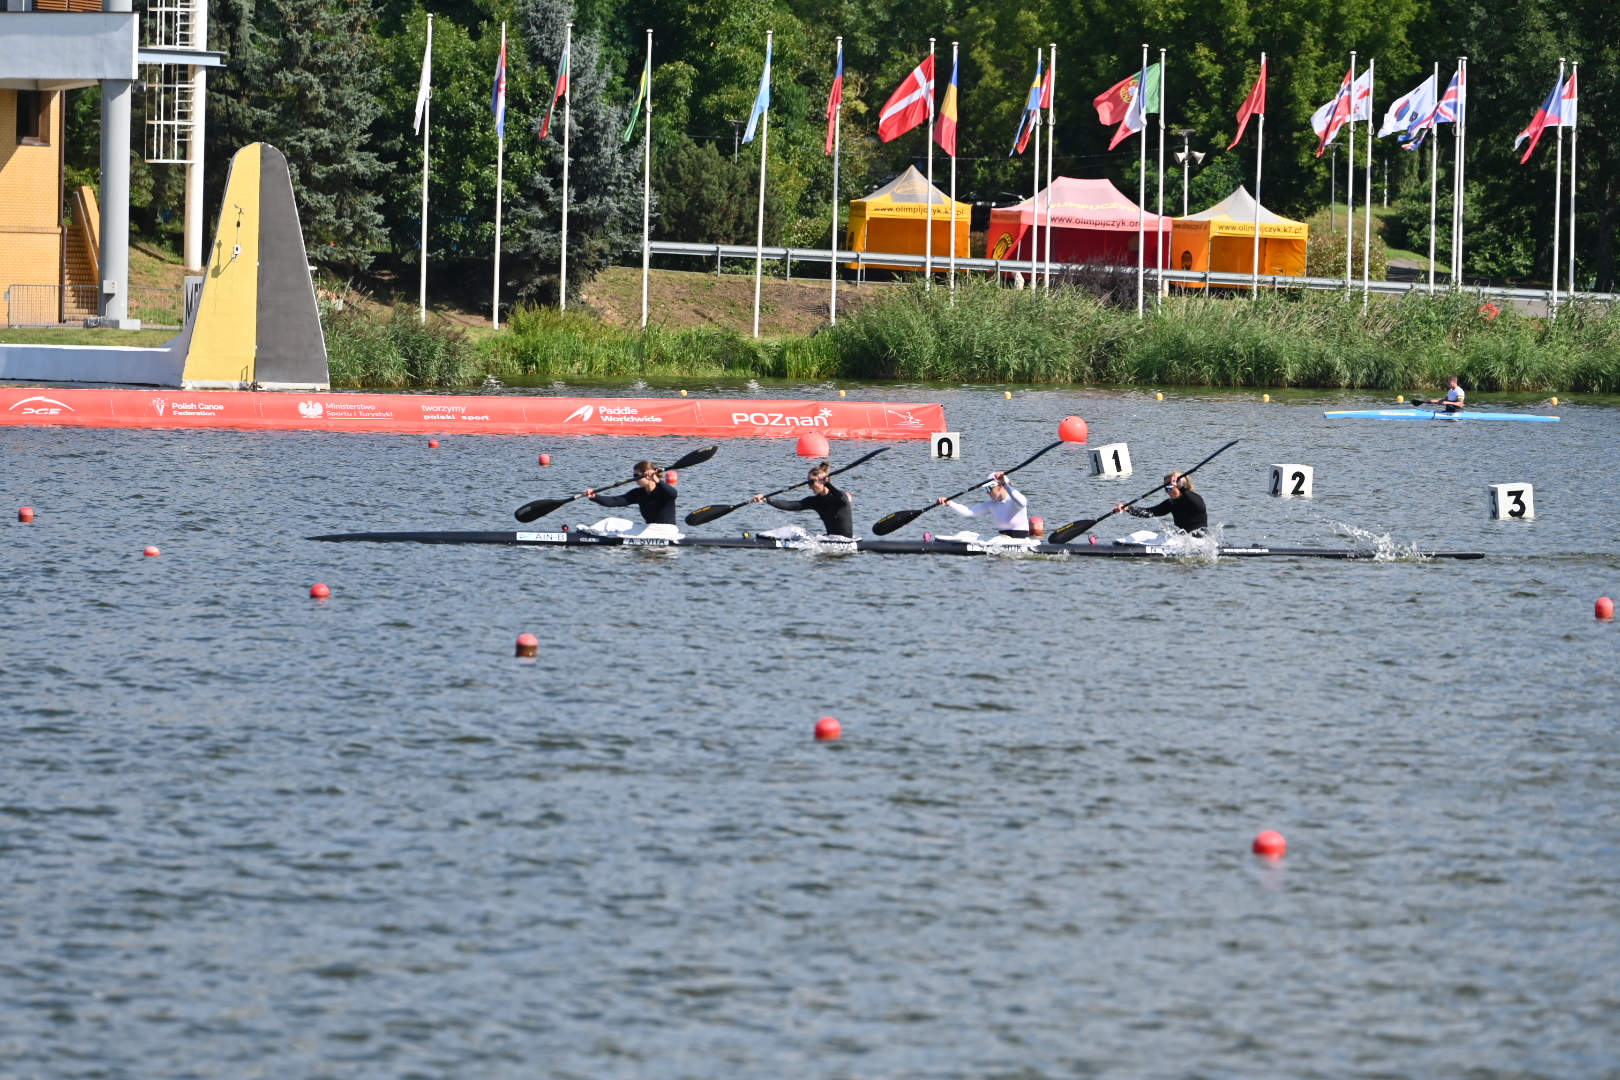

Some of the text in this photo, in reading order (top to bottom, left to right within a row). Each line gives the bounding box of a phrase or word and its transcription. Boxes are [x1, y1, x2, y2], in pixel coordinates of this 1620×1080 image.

[873, 206, 964, 217] www.olimpijcyk.k.pl
[1050, 216, 1142, 228] www.olimpijczyk.or
[1217, 224, 1303, 234] www.olimijczyk.k7.pl
[172, 402, 197, 410] Polish
[325, 402, 376, 410] Ministerstwo
[421, 404, 466, 413] tworzymy
[599, 406, 638, 415] Paddle
[326, 410, 352, 418] Sportu
[358, 410, 393, 418] Turystyki
[600, 415, 662, 423] Worldwide
[937, 437, 953, 458] 0
[1112, 449, 1122, 472] 1
[1271, 469, 1280, 494] 2
[1291, 471, 1306, 495] 2
[1490, 490, 1498, 518] 3
[1507, 490, 1526, 518] 3
[535, 533, 565, 541] AIN-B
[640, 538, 665, 546] SVITA
